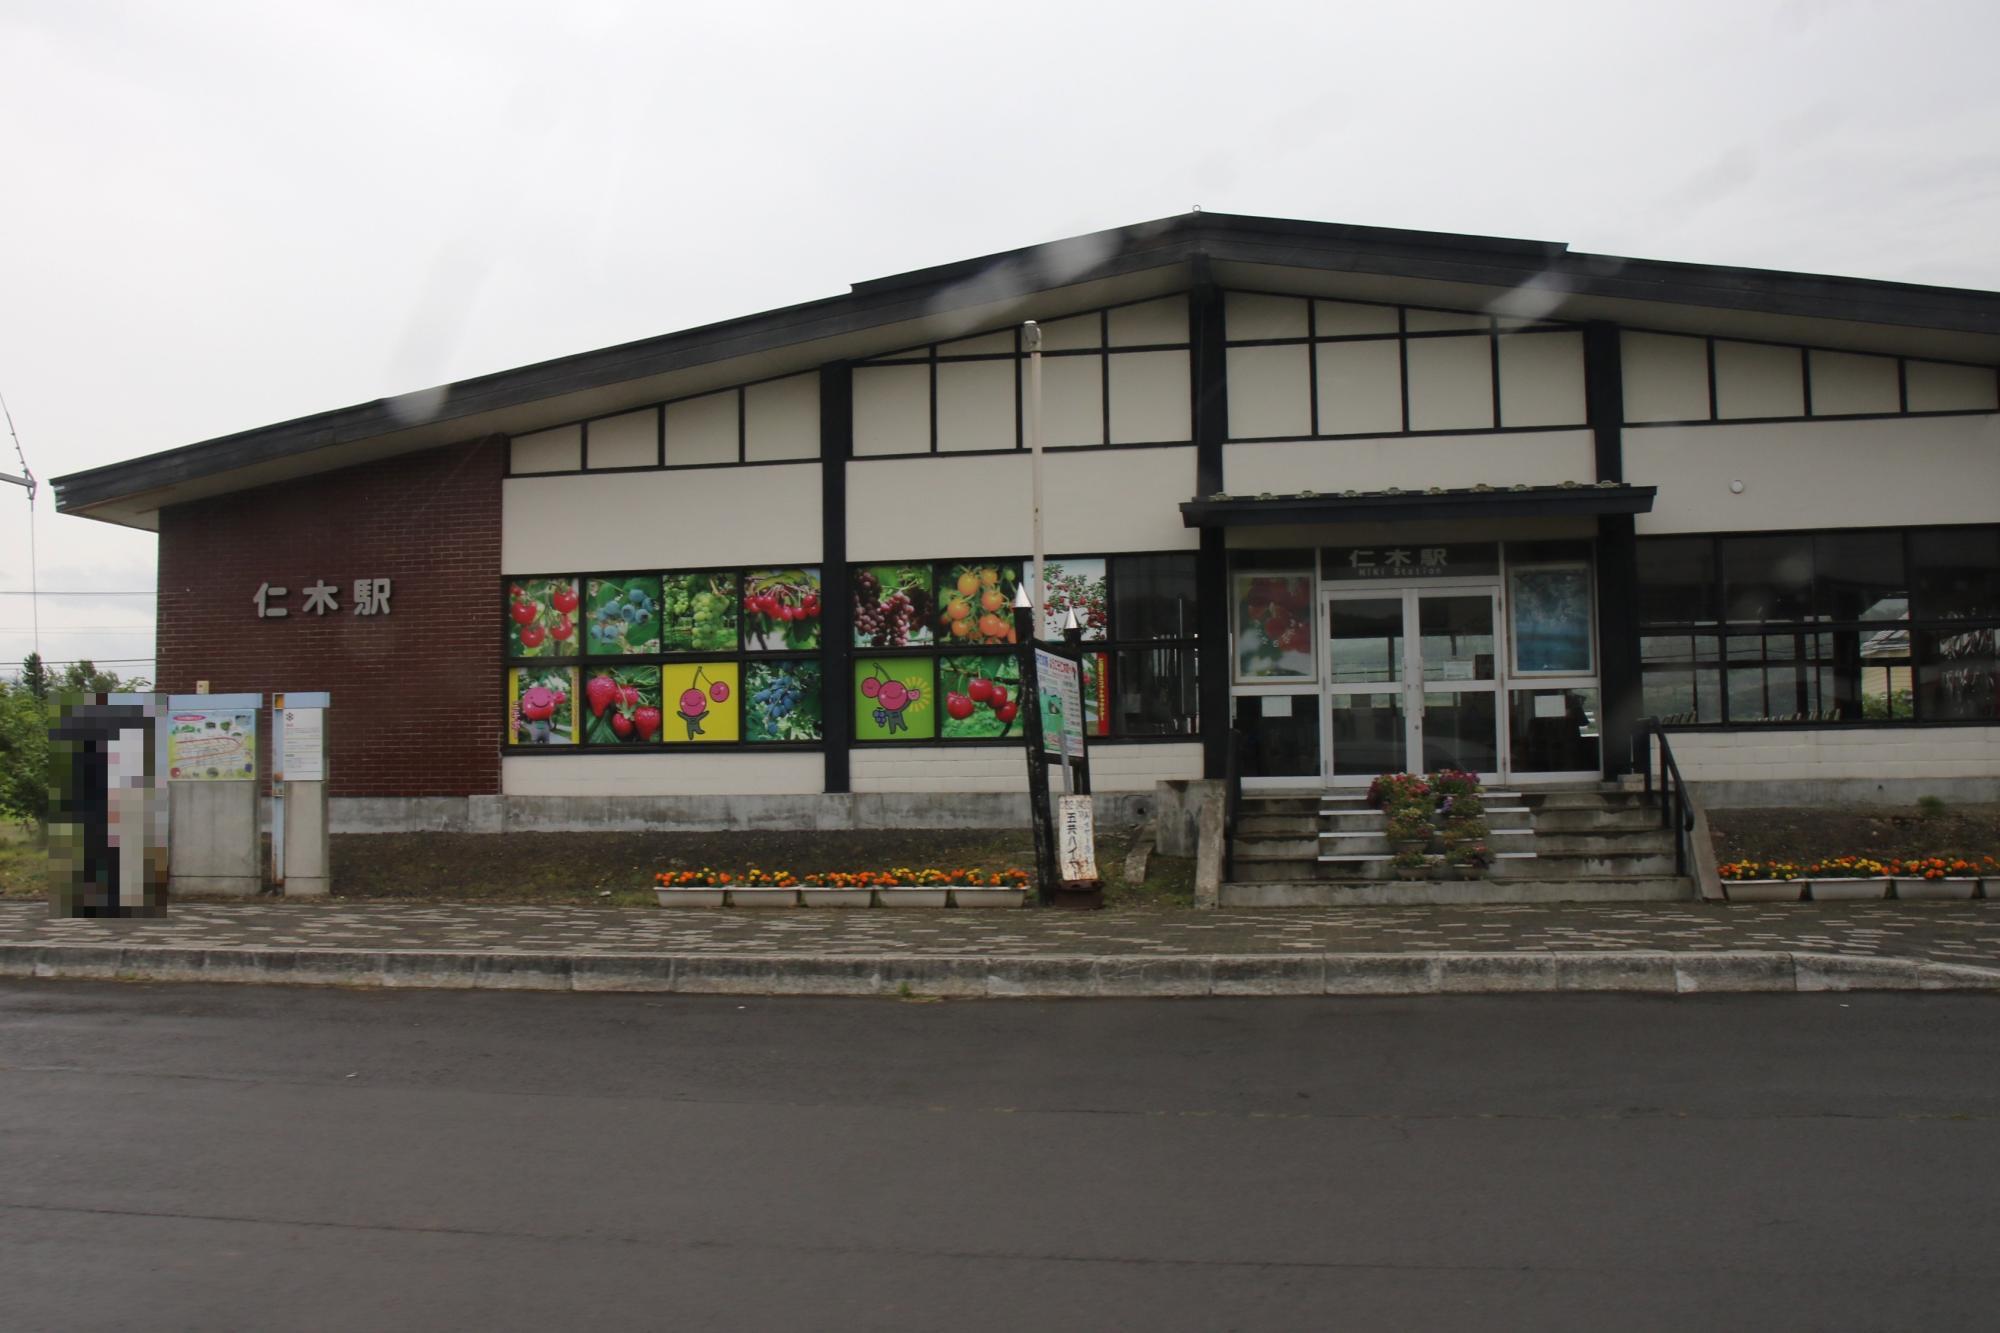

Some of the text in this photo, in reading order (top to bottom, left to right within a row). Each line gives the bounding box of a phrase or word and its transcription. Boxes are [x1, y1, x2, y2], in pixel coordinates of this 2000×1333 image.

[1349, 548, 1449, 568] 仁木駅
[1393, 567, 1442, 576] Station
[253, 578, 391, 618] 仁木駅
